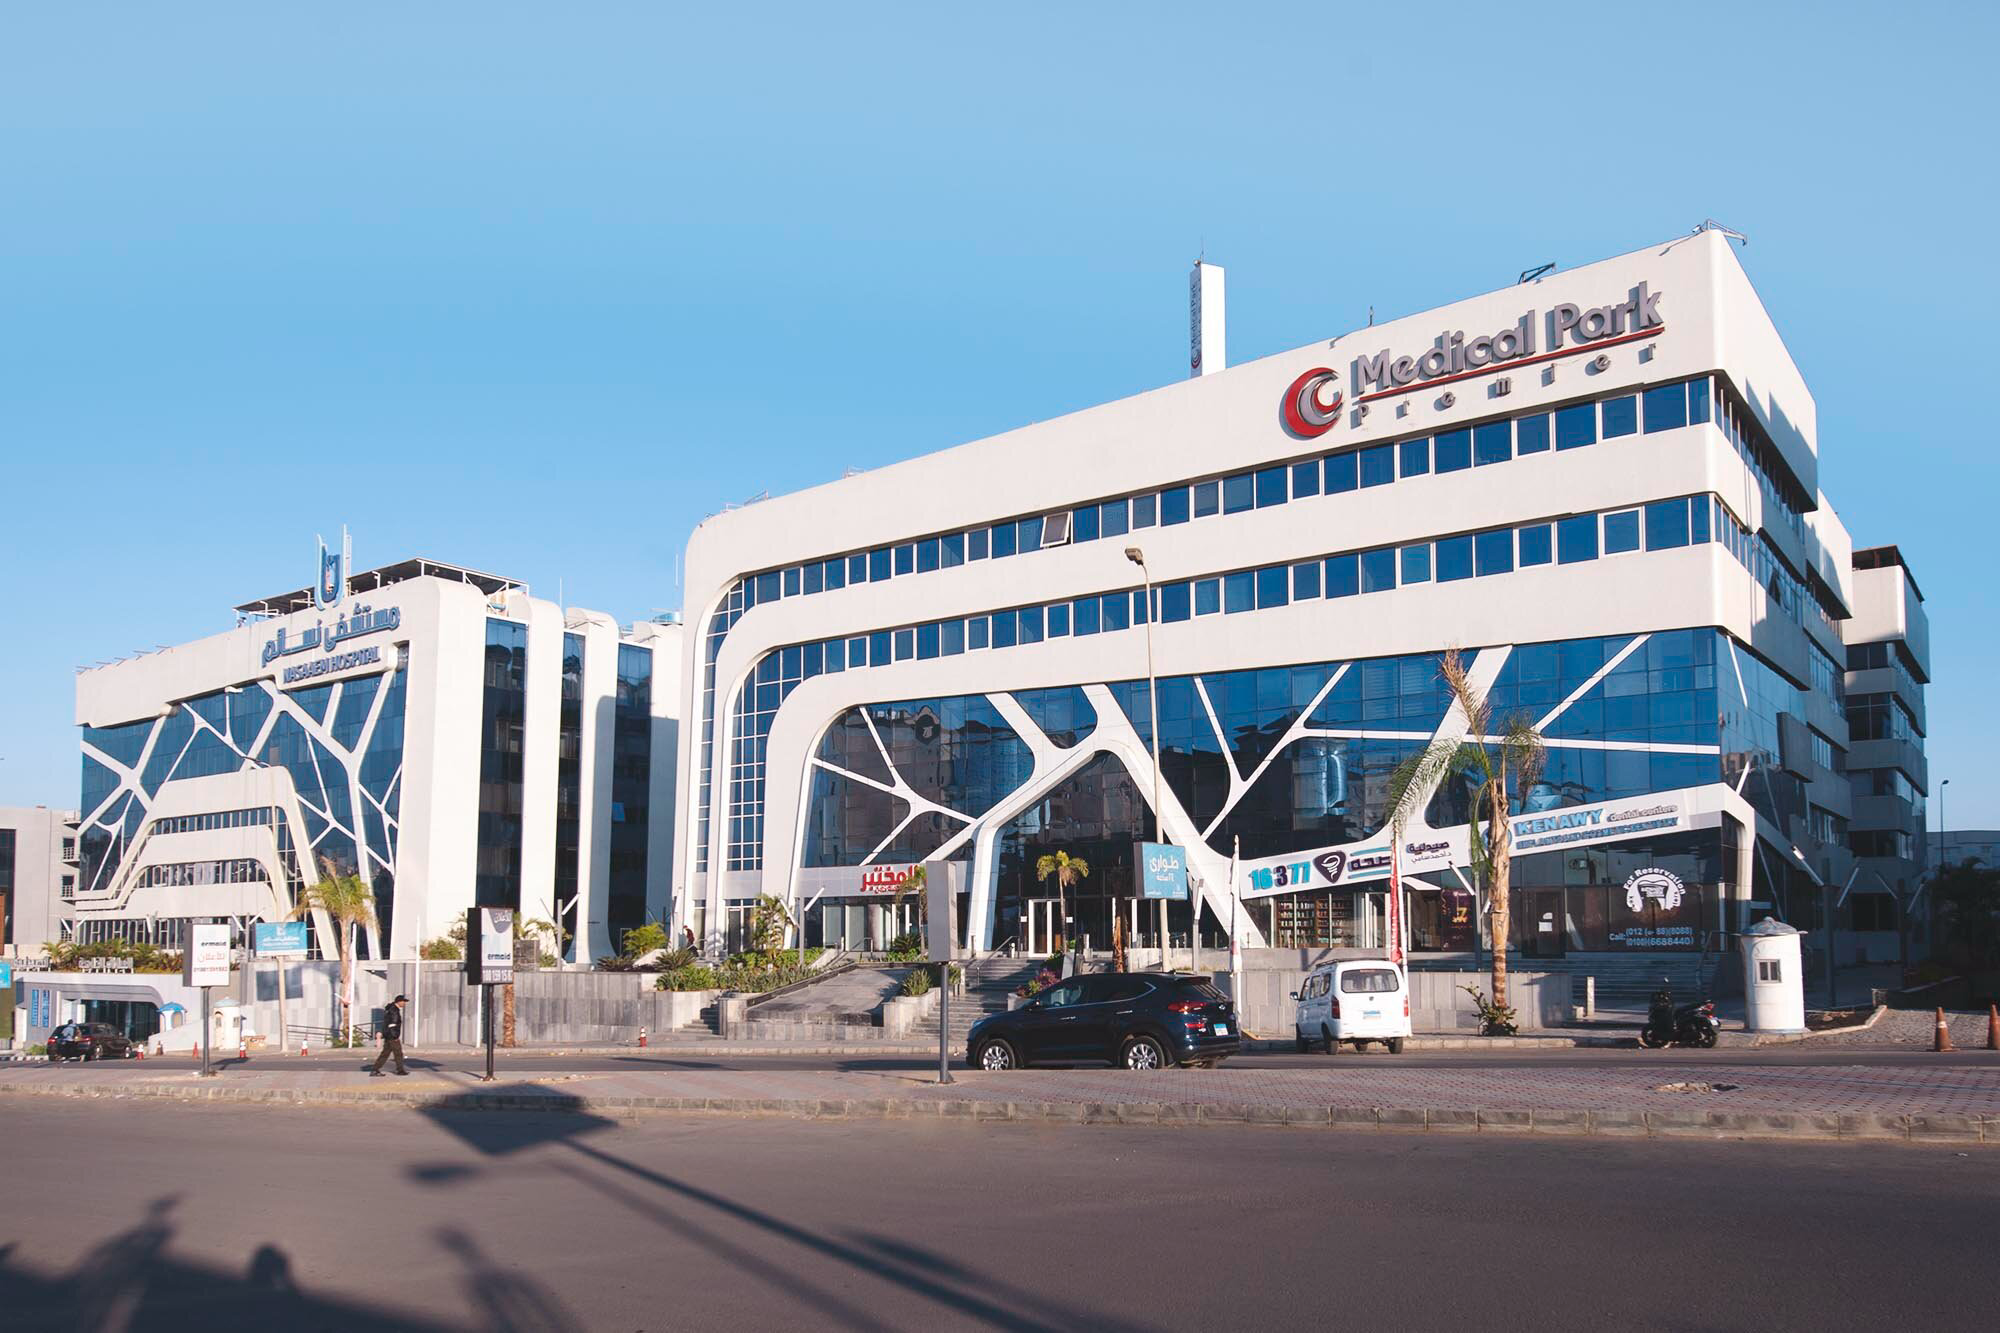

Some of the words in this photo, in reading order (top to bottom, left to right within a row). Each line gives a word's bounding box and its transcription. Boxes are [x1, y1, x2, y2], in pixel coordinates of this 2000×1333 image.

[1353, 309, 1536, 396] Medical
[1549, 280, 1665, 351] Park
[324, 602, 401, 653] مستشفى
[283, 658, 330, 684] NASAAEM
[331, 646, 380, 671] HOSPITAL
[1514, 808, 1604, 836] KENAWY
[1406, 840, 1450, 855] صيدلية
[860, 864, 916, 893] لمختبر
[1249, 861, 1311, 891] 16377
[1623, 876, 1635, 891] For
[1635, 867, 1687, 895] Reservation
